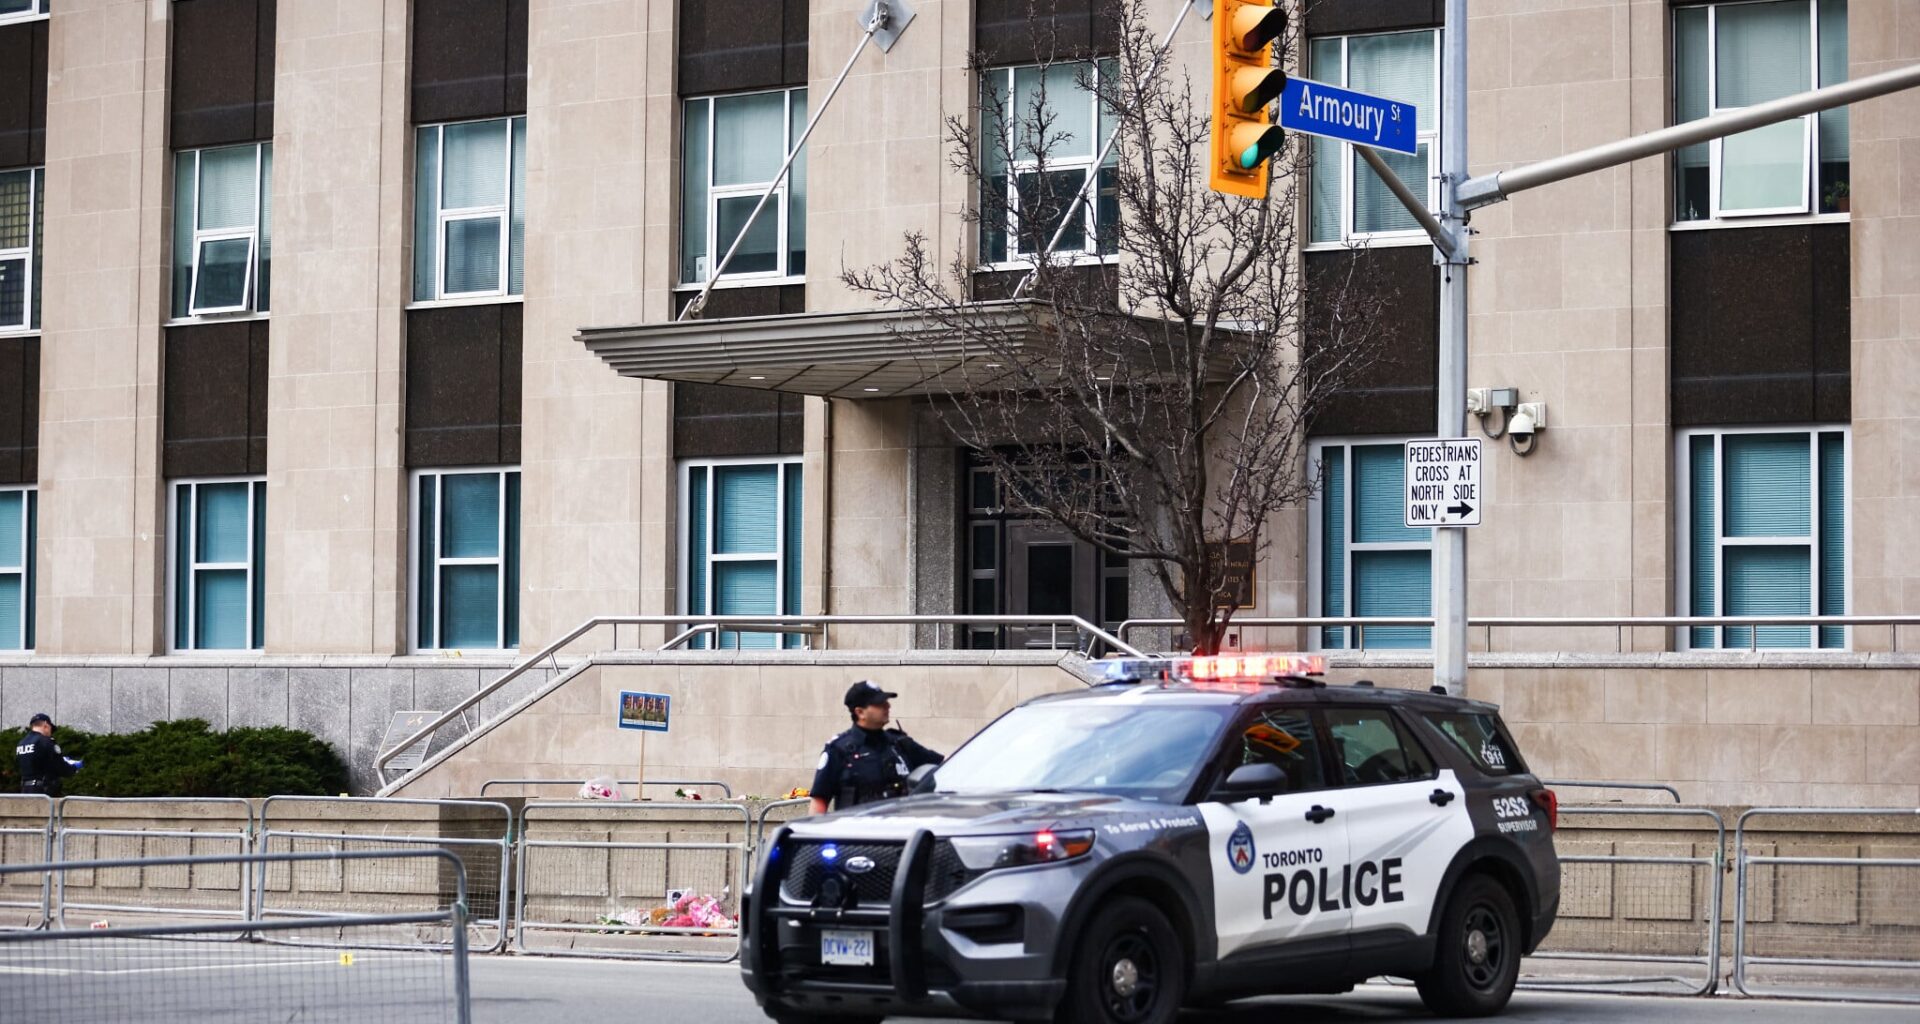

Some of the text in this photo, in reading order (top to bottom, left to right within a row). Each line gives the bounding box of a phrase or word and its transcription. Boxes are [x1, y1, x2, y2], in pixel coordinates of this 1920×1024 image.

[1298, 84, 1401, 142] Armoury St
[1409, 445, 1479, 463] PEDESTRIANS
[1415, 464, 1472, 482] CROSS AT
[1411, 483, 1476, 501] NORTH SIDE
[1411, 503, 1438, 521] ONLY
[16, 744, 35, 755] POLICE
[1487, 750, 1505, 764] 911
[1103, 824, 1120, 834] To
[1159, 816, 1198, 829] Protect
[1497, 819, 1538, 833] SUPERVISOR
[1262, 848, 1323, 868] TORONTO
[1262, 857, 1405, 920] POLICE
